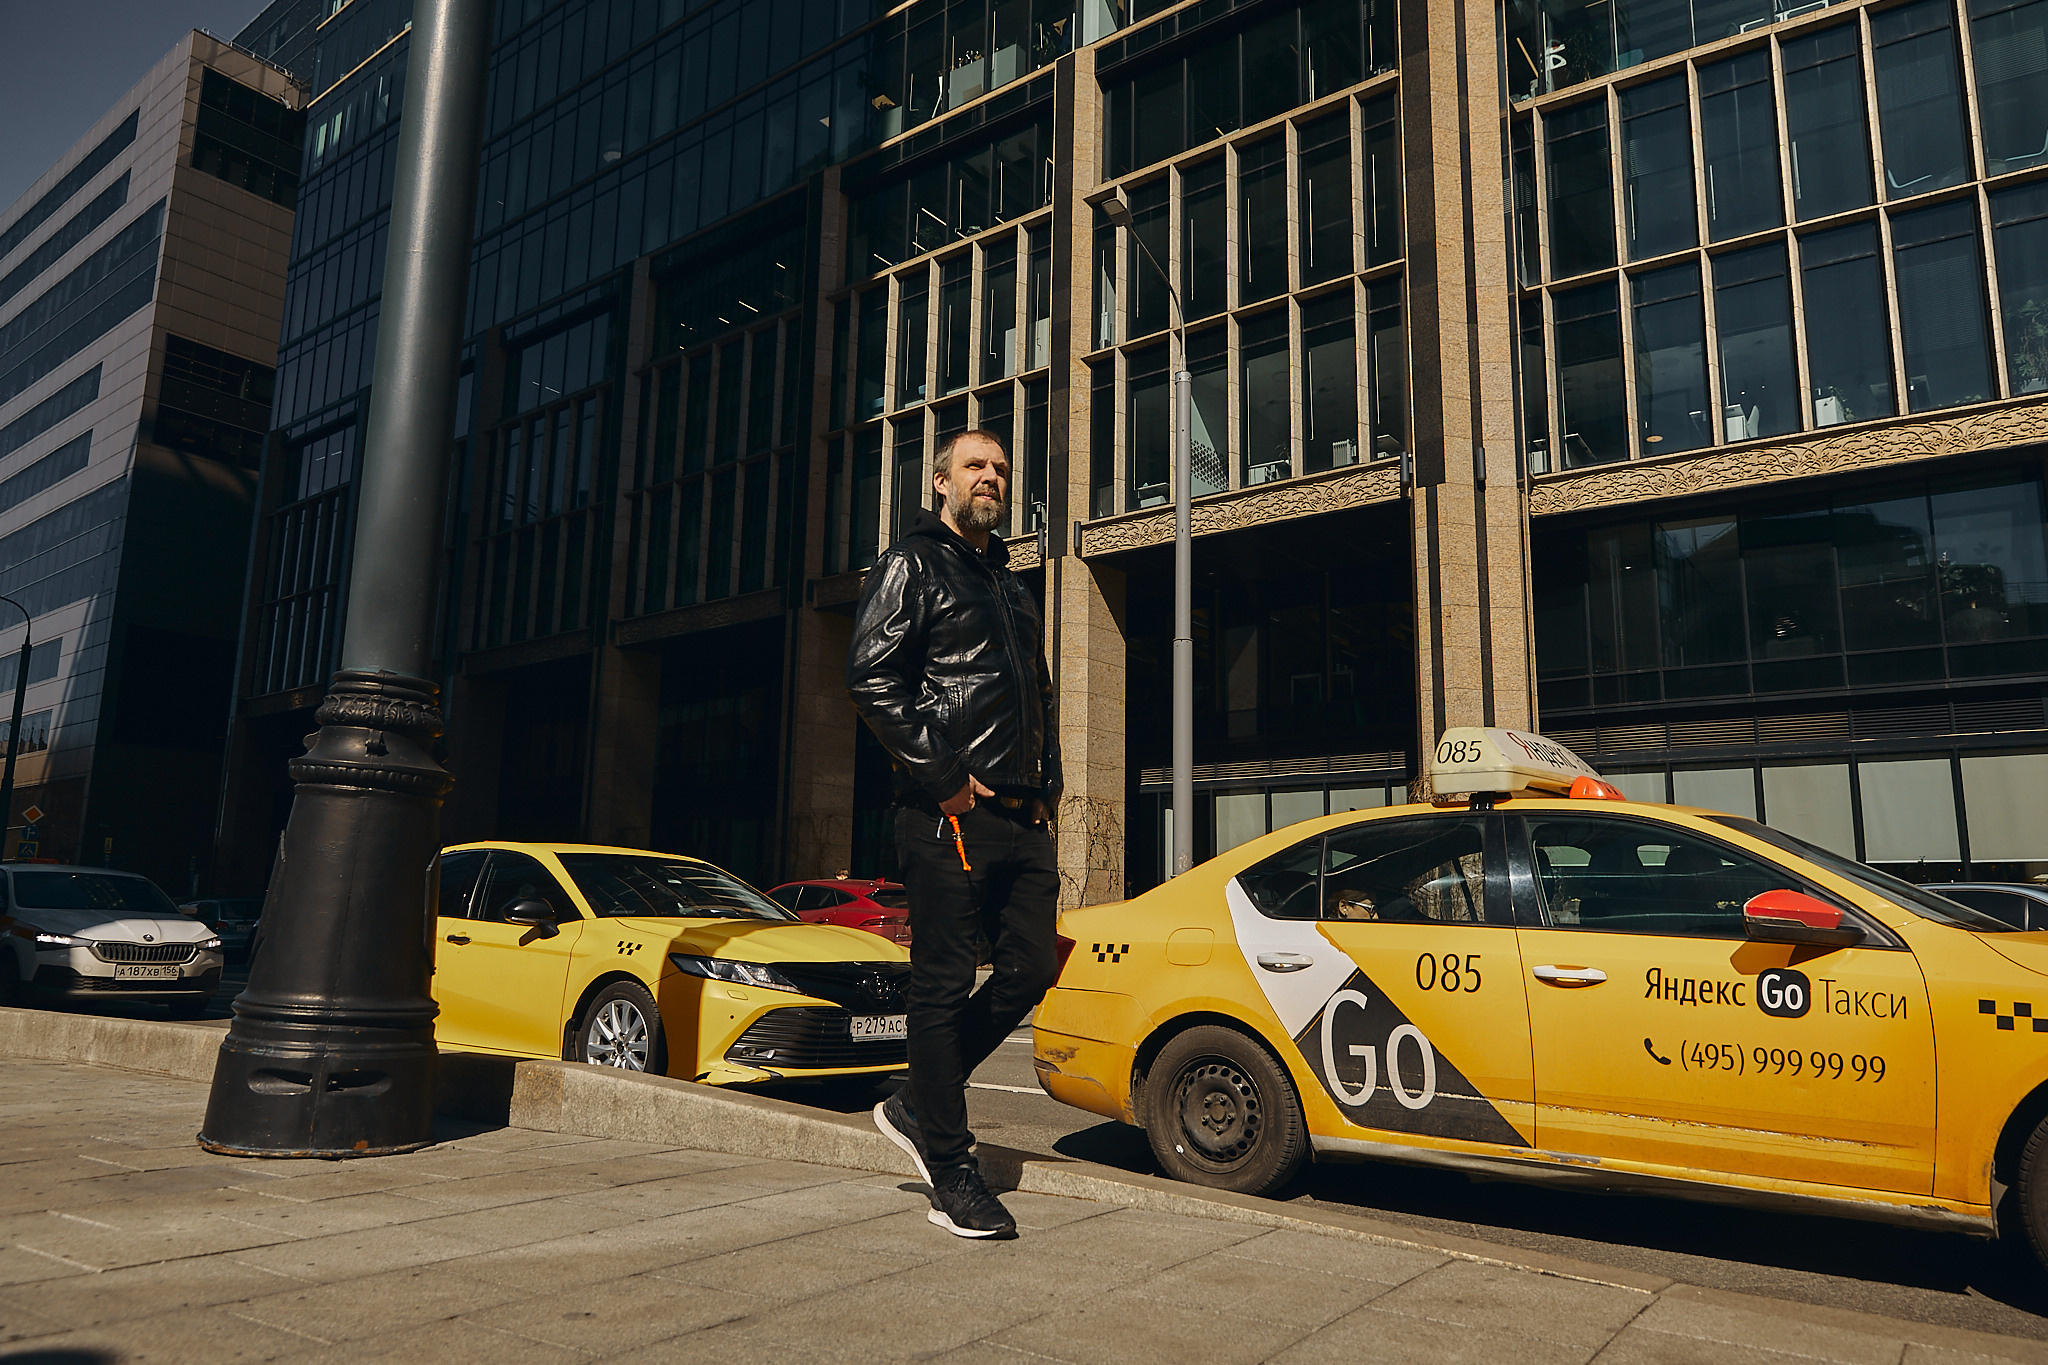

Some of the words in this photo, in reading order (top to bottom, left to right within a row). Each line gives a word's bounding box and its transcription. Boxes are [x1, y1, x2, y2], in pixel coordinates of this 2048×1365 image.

[1437, 740, 1482, 764] 085
[1416, 952, 1482, 994] 085
[1644, 967, 1746, 1007] Яндекс
[1761, 973, 1804, 1010] Go
[1818, 978, 1908, 1019] Такси
[1680, 1039, 1745, 1076] (495)
[1753, 1047, 1803, 1077] 999
[1810, 1051, 1844, 1080] 99
[1851, 1054, 1886, 1083] 99
